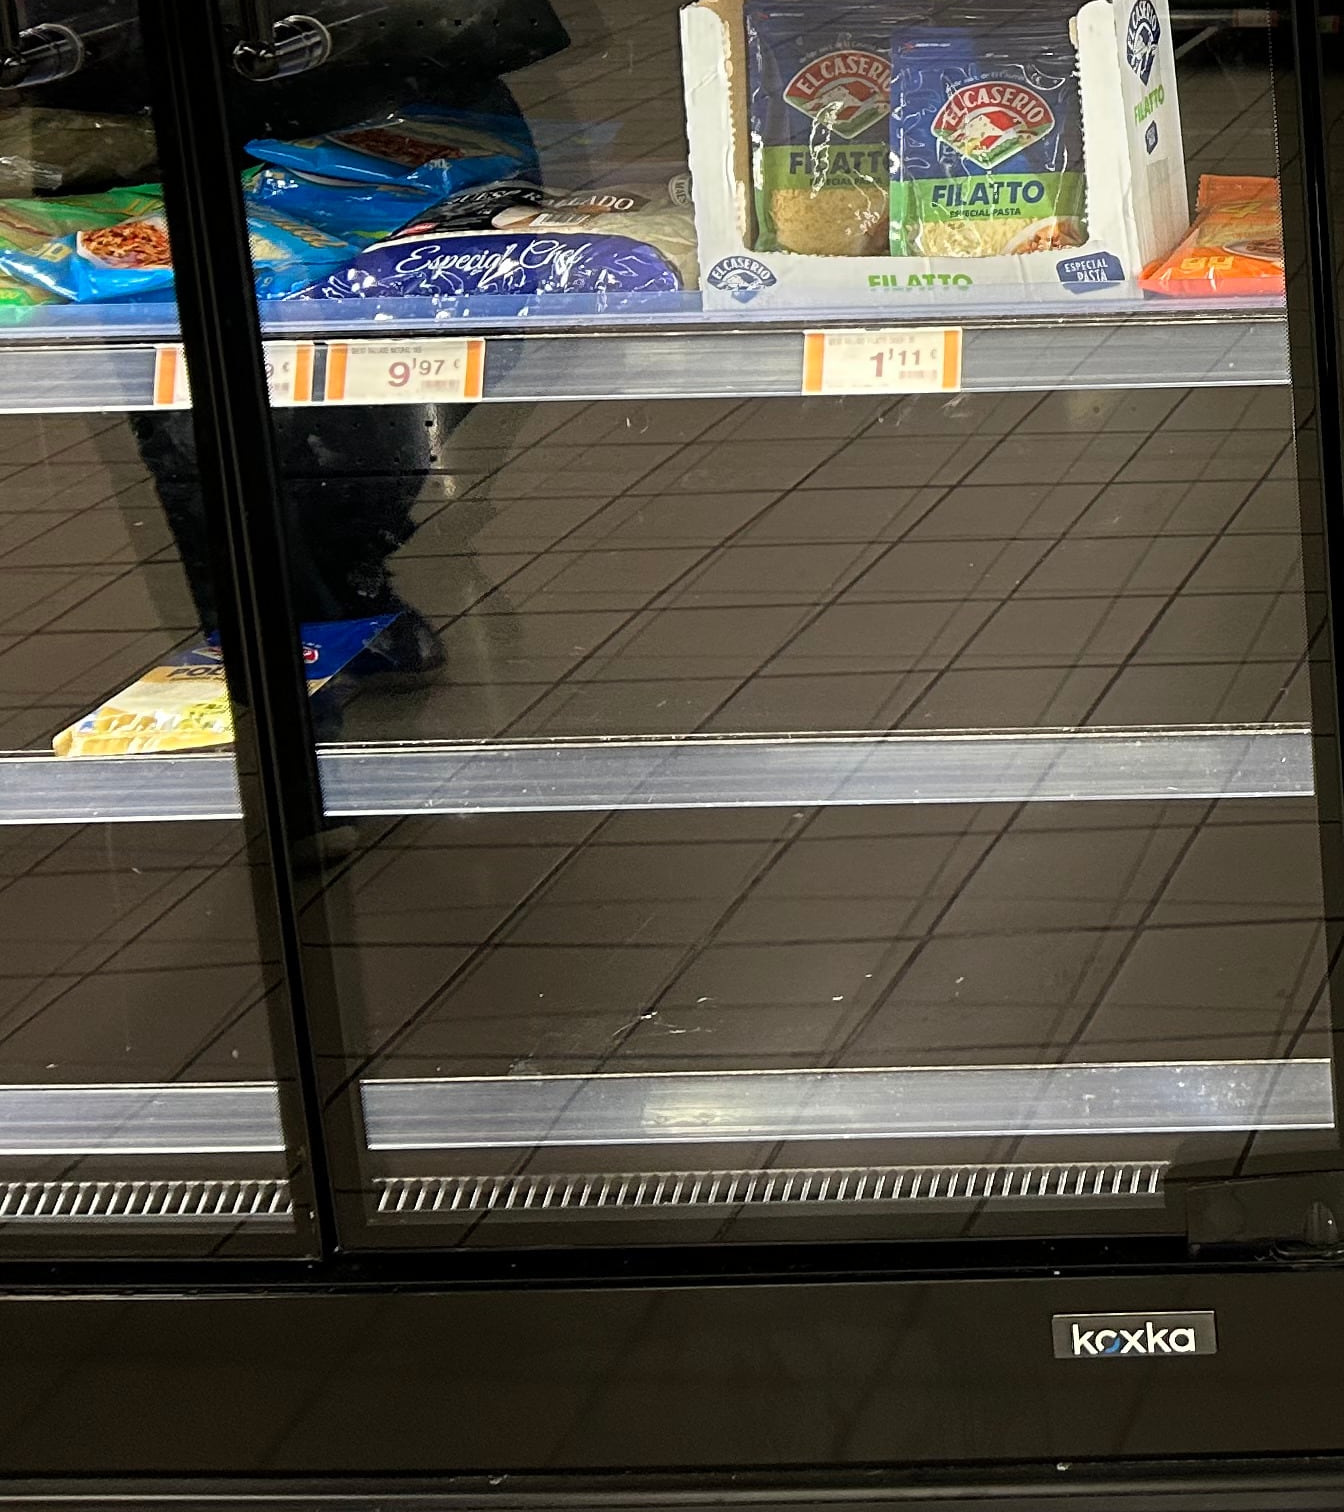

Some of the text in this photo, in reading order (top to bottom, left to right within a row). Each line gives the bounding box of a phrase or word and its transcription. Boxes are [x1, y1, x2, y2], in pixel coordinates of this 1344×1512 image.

[963, 88, 1045, 124] CASERIO
[1133, 84, 1165, 127] FILATTO
[932, 181, 1045, 207] FILATTO
[993, 208, 1022, 217] PASTA
[1064, 259, 1108, 272] ESPECIAL
[1072, 1322, 1197, 1356] koxka
